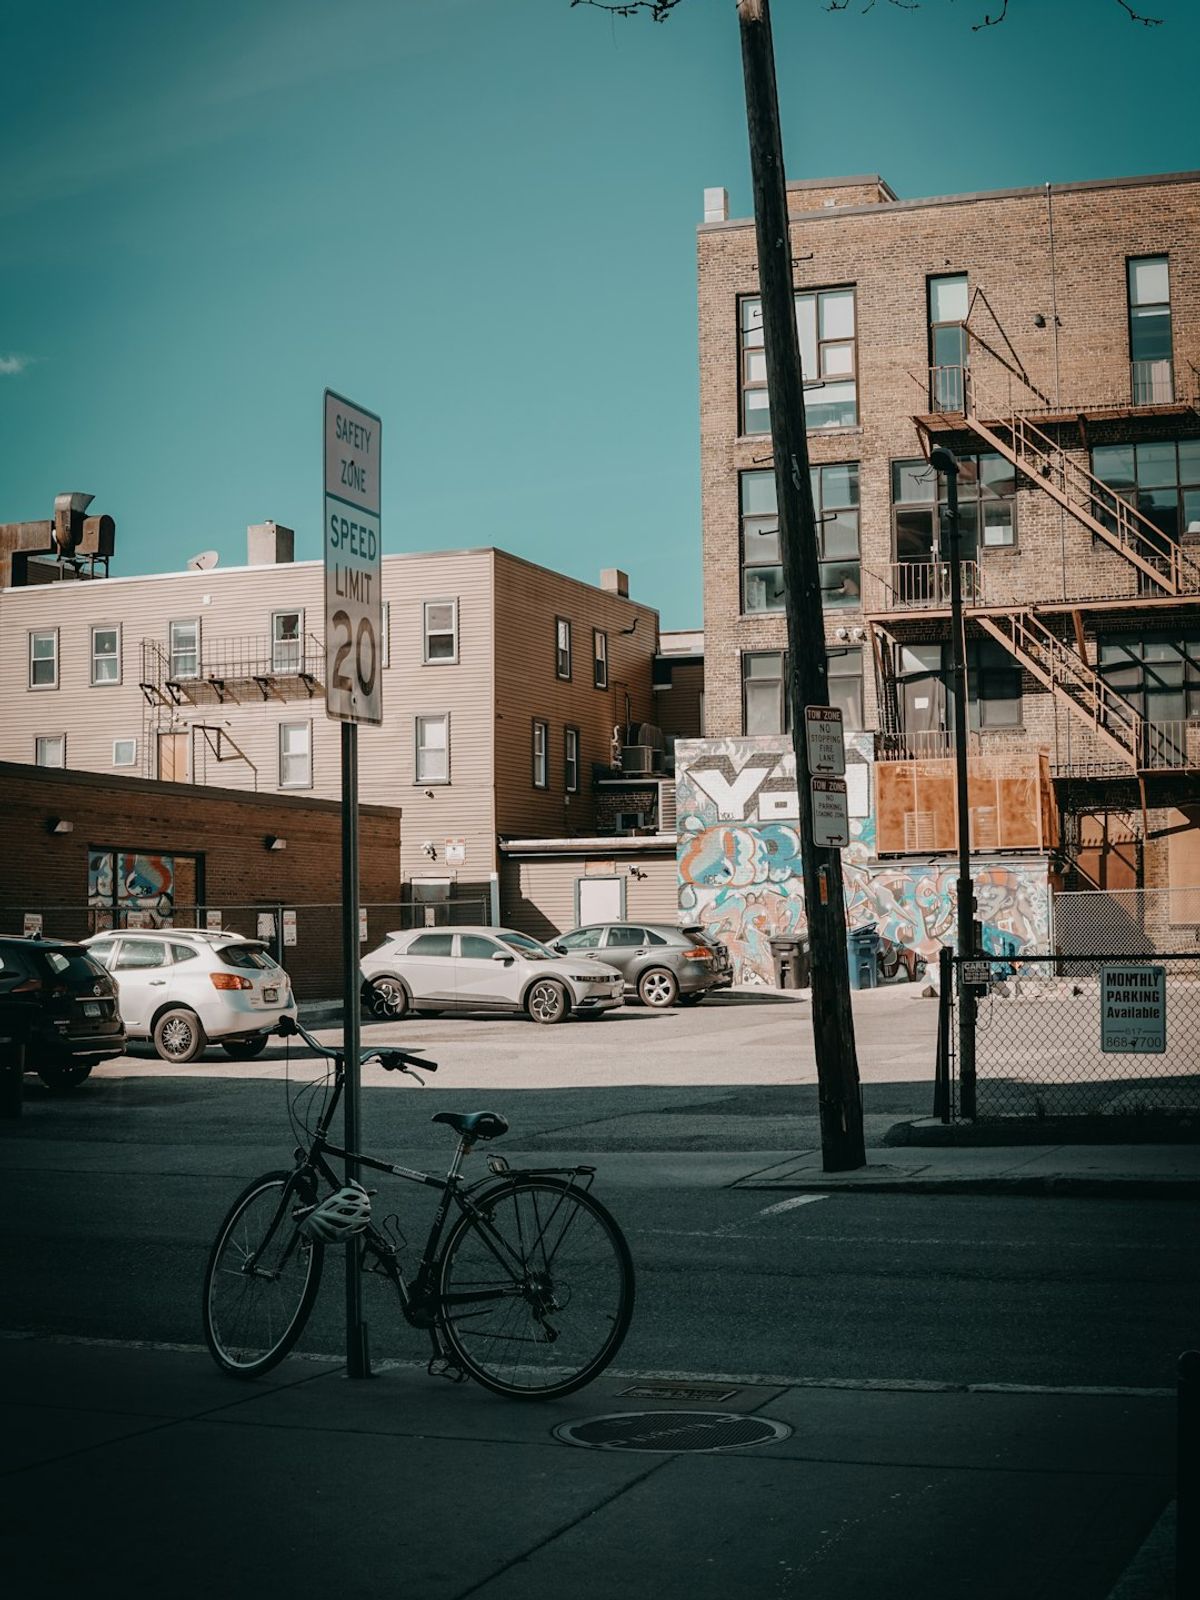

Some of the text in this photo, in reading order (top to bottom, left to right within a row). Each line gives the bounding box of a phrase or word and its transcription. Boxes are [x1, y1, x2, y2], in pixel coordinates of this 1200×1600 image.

[335, 413, 372, 454] SAFETY
[340, 459, 366, 494] ZONE
[330, 513, 377, 562] SPEED
[335, 562, 373, 606] LIMIT
[331, 609, 376, 697] 20
[807, 709, 841, 721] TOW ZONE
[819, 723, 831, 734] NO
[810, 734, 841, 744] STOPPING
[819, 744, 833, 754] FIRE
[819, 753, 836, 763] LANE
[813, 779, 847, 792] TOW ZONE
[825, 794, 835, 802] NO
[817, 802, 843, 811] PARKING
[1106, 972, 1159, 988] MONTHLY
[1106, 990, 1160, 1003] PARKING
[1106, 1006, 1160, 1020] Available
[1124, 1027, 1143, 1036] 617
